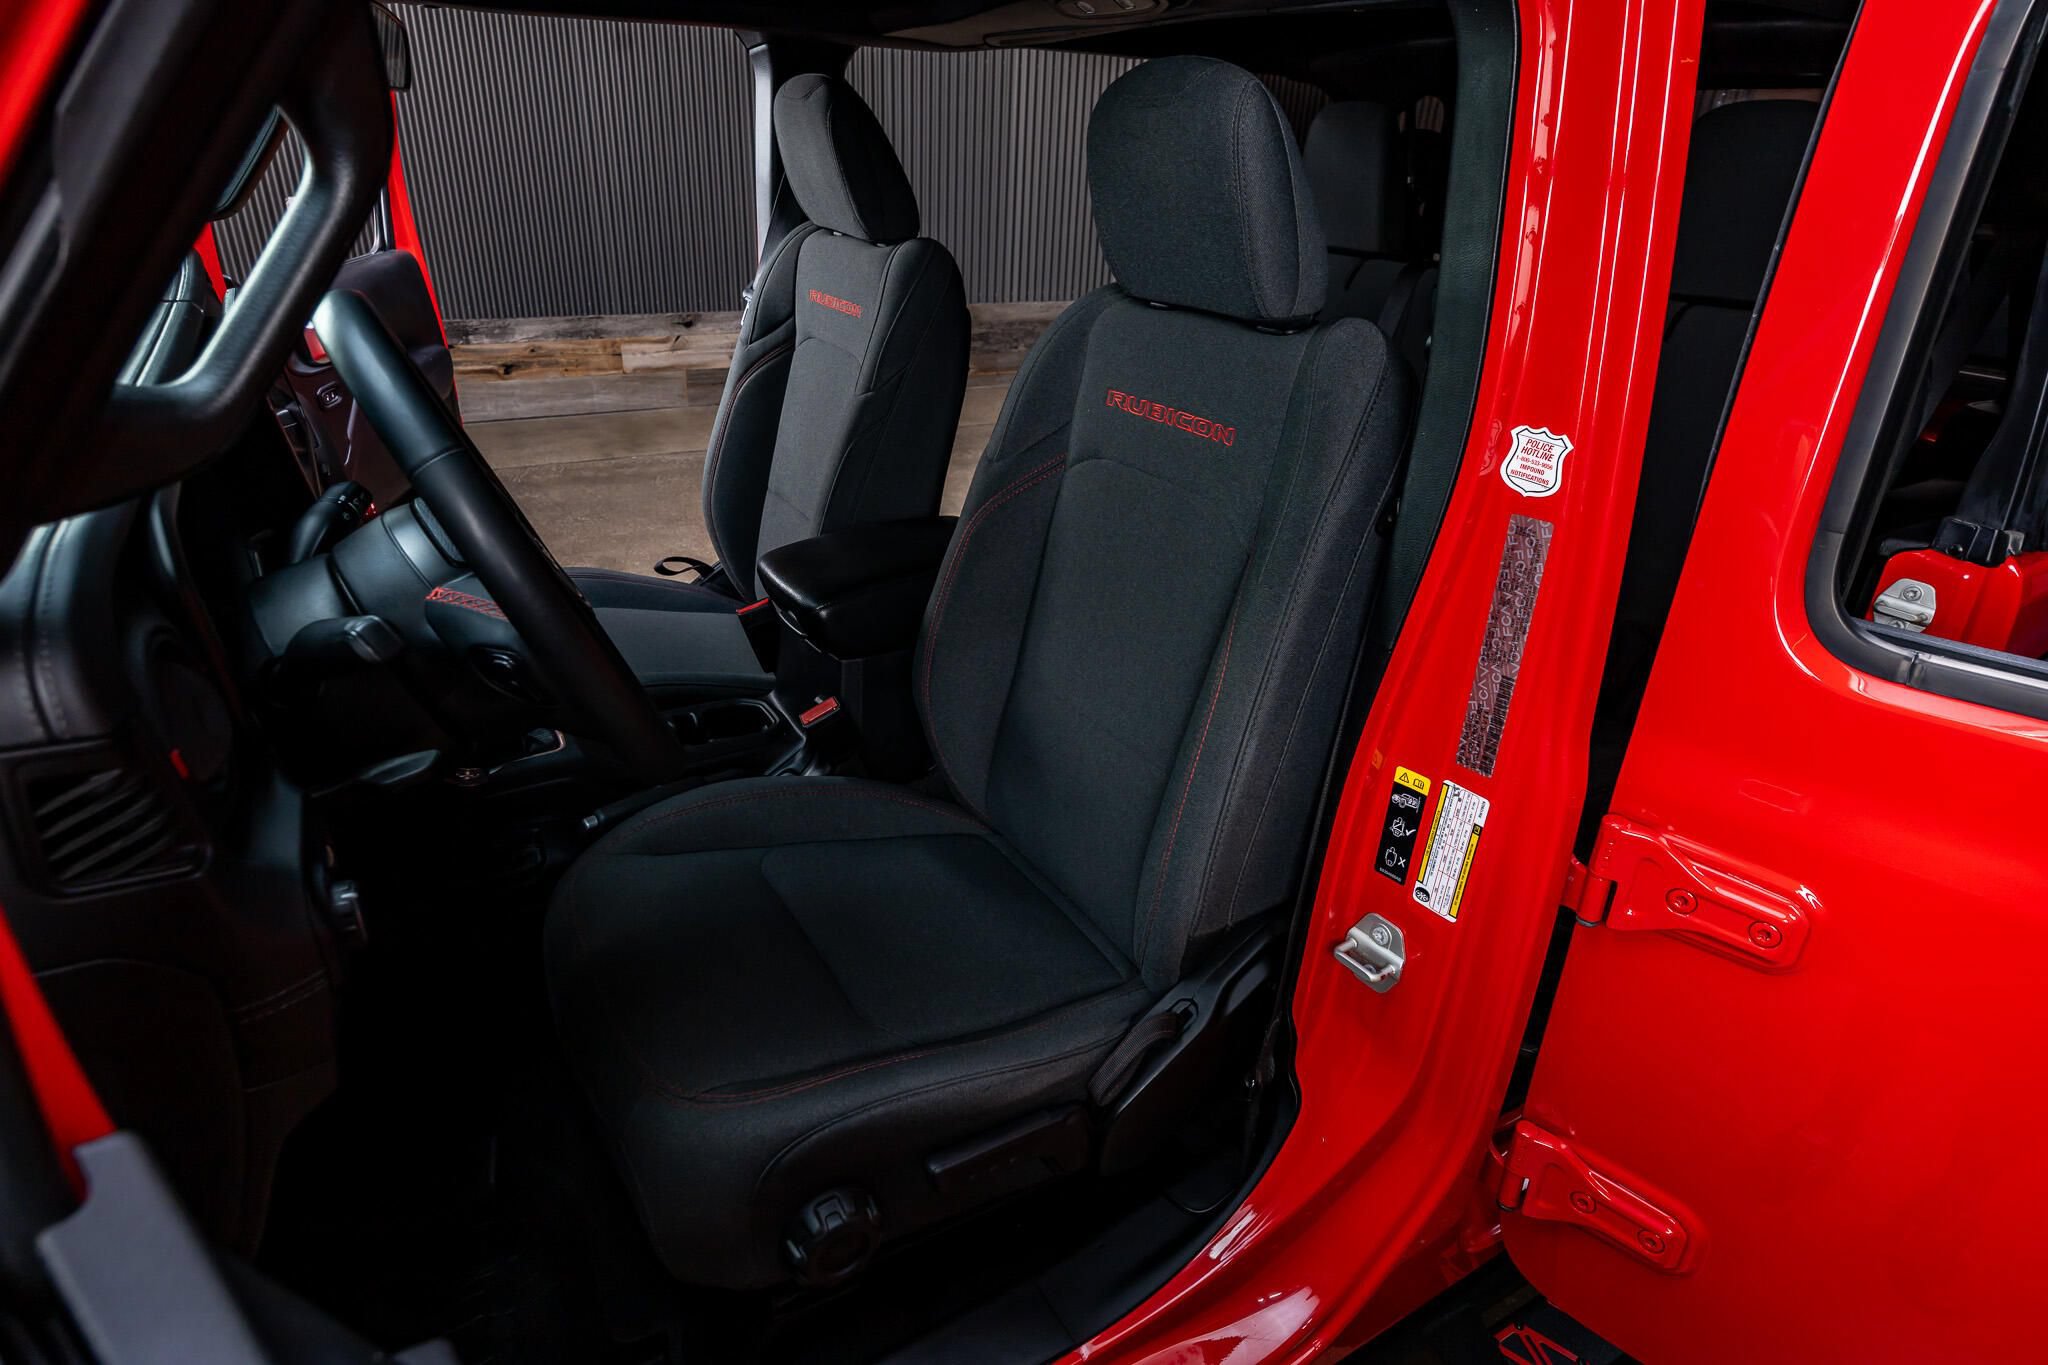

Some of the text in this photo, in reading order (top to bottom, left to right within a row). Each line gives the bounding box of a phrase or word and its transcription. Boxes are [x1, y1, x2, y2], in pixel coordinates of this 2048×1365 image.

[809, 289, 862, 319] RUBICON
[1106, 389, 1236, 447] RUBICON
[1520, 446, 1555, 462] HOTLINE
[1526, 439, 1555, 453] POLICE
[1510, 469, 1550, 486] NOTIFICATIONS
[1519, 463, 1545, 476] IMPOUND
